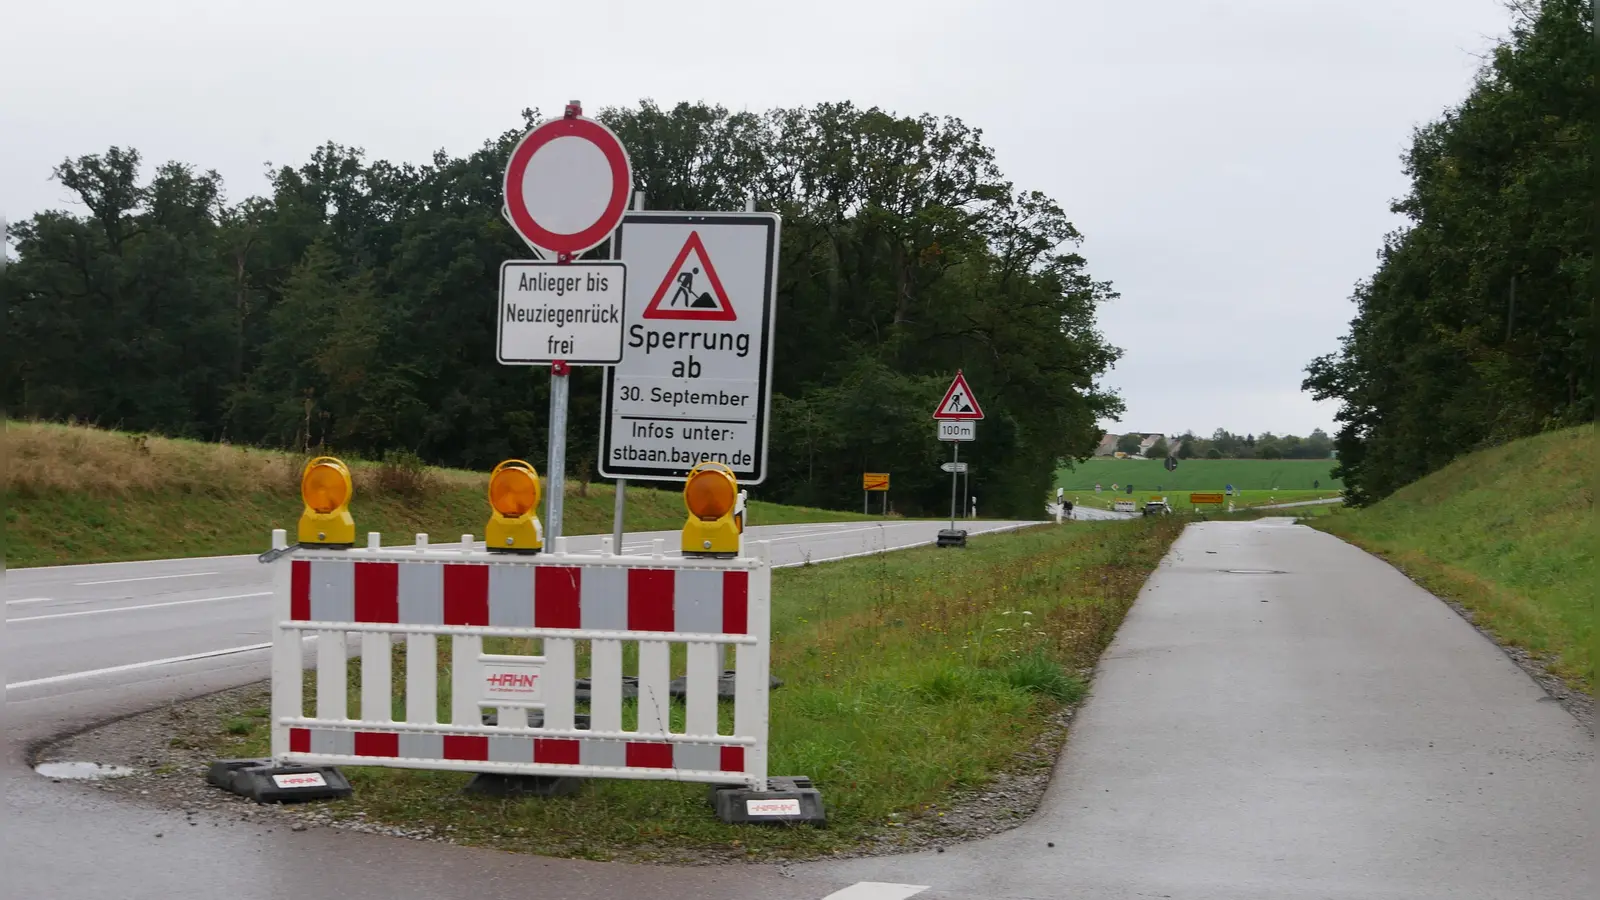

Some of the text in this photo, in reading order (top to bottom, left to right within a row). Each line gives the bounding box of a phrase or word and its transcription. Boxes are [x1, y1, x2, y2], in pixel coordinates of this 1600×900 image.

[518, 272, 609, 296] Anlieger bis
[506, 303, 619, 328] Neuziegenrück
[548, 335, 574, 354] frei
[628, 324, 750, 357] Sperrung
[671, 355, 701, 379] ab
[620, 386, 749, 407] 30. September
[632, 422, 734, 441] Infos unter:
[613, 445, 752, 467] stbaan.bayern.de
[486, 674, 538, 687] HAHN
